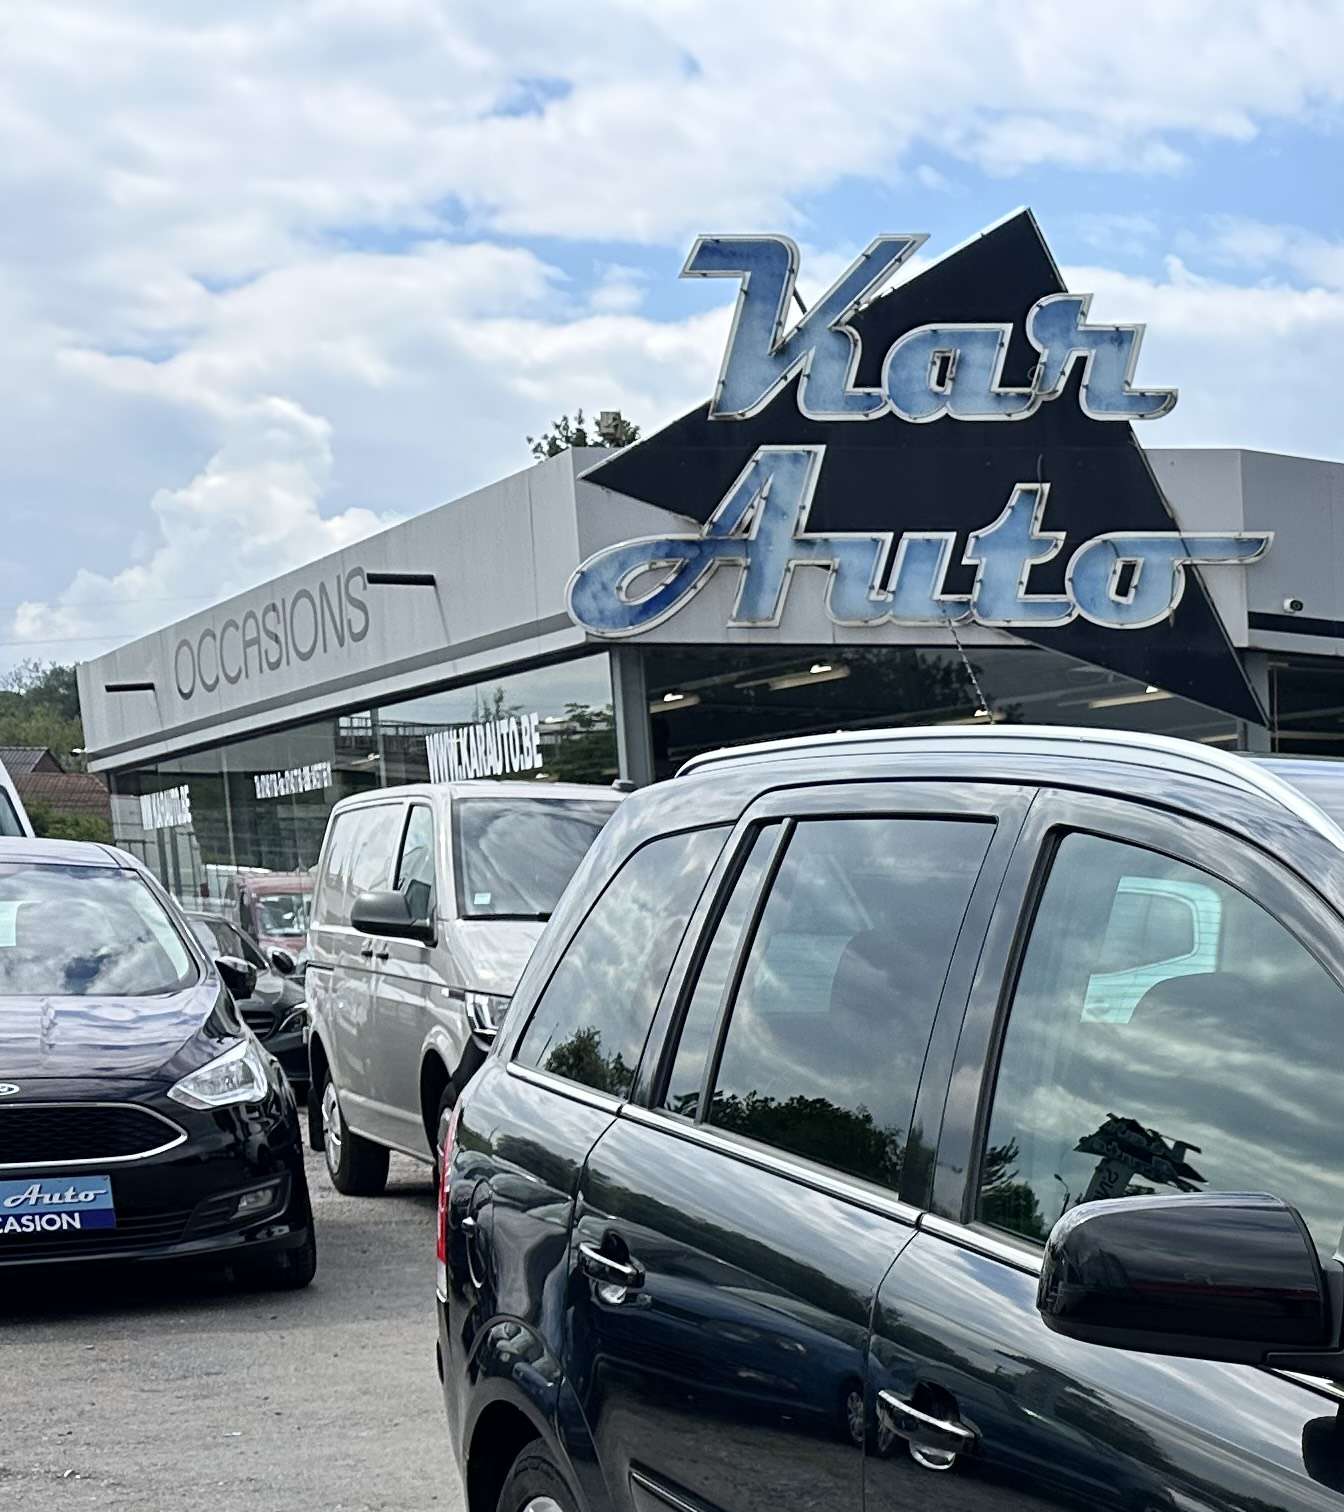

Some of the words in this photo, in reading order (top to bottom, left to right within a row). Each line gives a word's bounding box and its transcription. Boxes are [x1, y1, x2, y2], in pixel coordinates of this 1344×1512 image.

[679, 233, 1178, 424] Kar
[564, 445, 1275, 638] Auto
[174, 566, 370, 700] OCCASIONS
[425, 712, 544, 784] WWW.KARAUTO.BE
[0, 1212, 81, 1234] ASION
[4, 1184, 108, 1208] Auto
